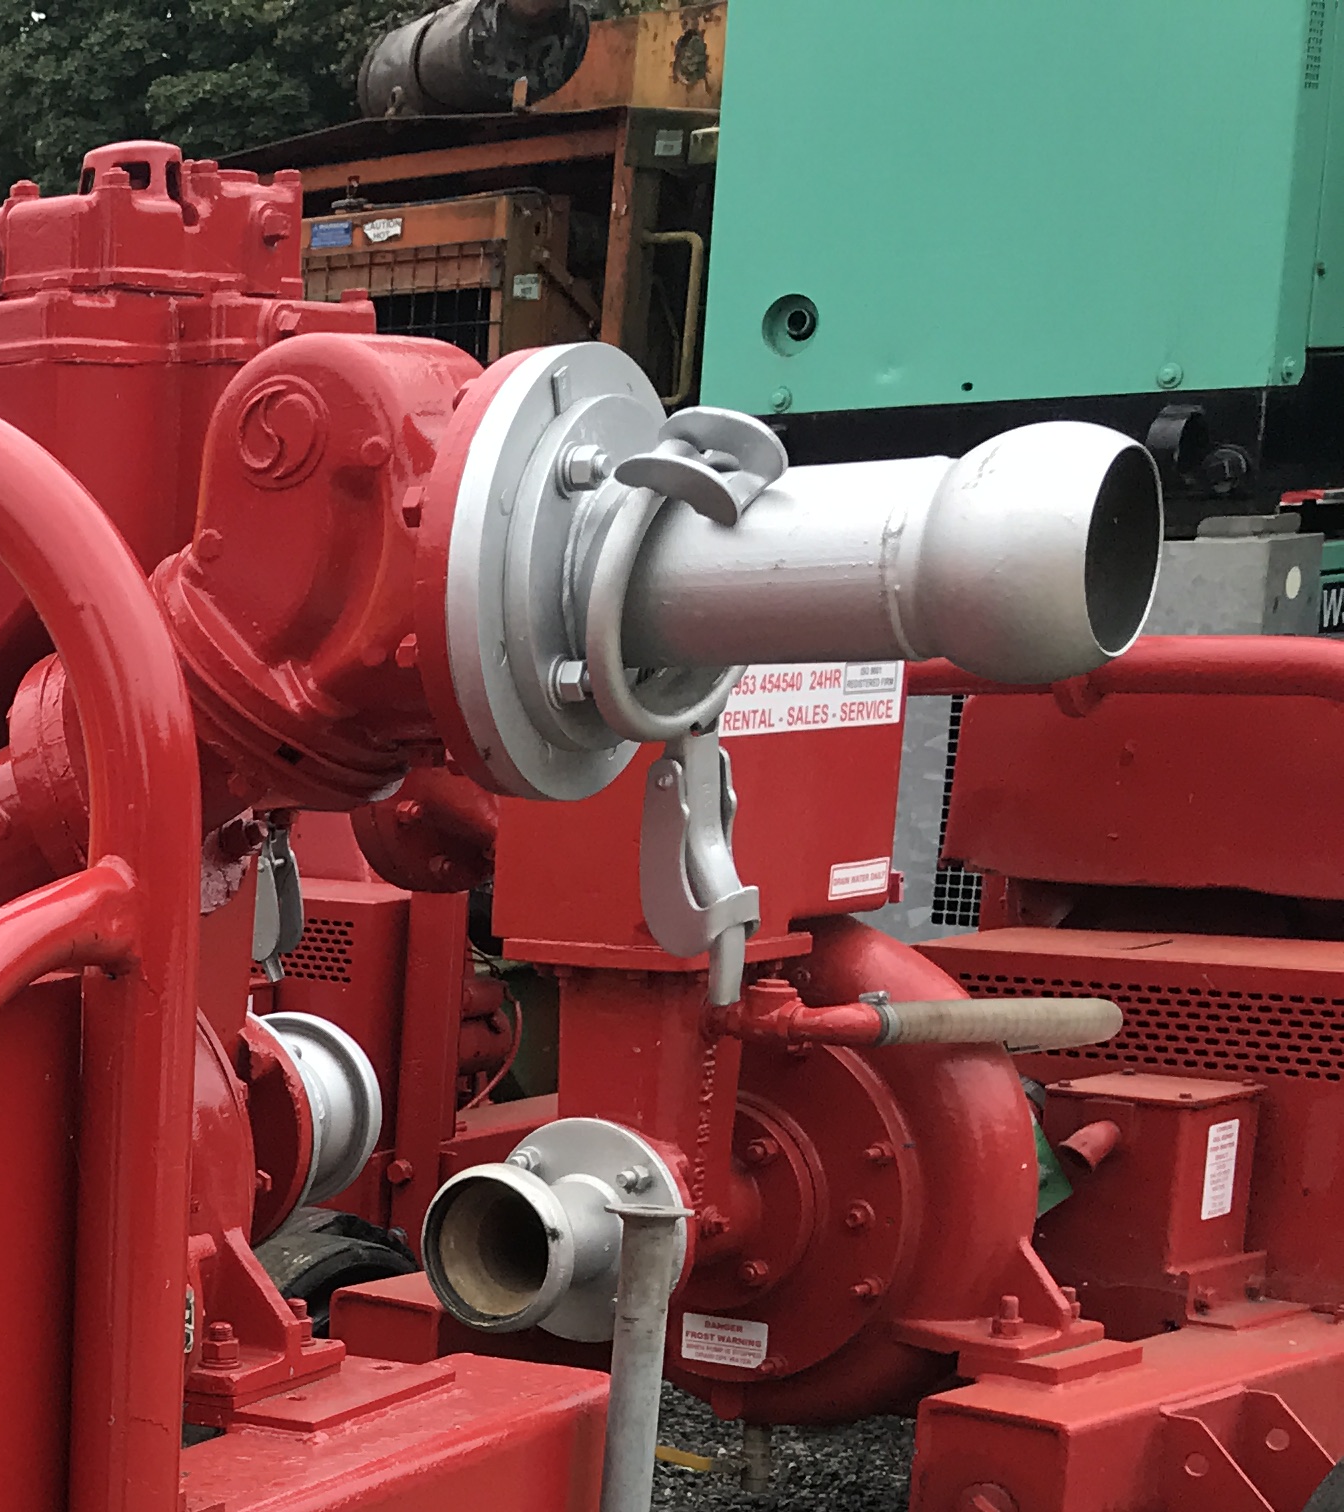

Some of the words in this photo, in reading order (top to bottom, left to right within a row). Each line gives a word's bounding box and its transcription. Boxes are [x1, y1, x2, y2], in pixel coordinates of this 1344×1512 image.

[759, 671, 803, 694] 454540
[809, 668, 842, 691] 24HR
[723, 708, 775, 732] RENTAL
[787, 703, 829, 727] SALES
[840, 699, 894, 722] SERVICE
[704, 1320, 743, 1333] DANGER
[685, 1330, 715, 1342] FROST
[717, 1334, 762, 1348] WARNING
